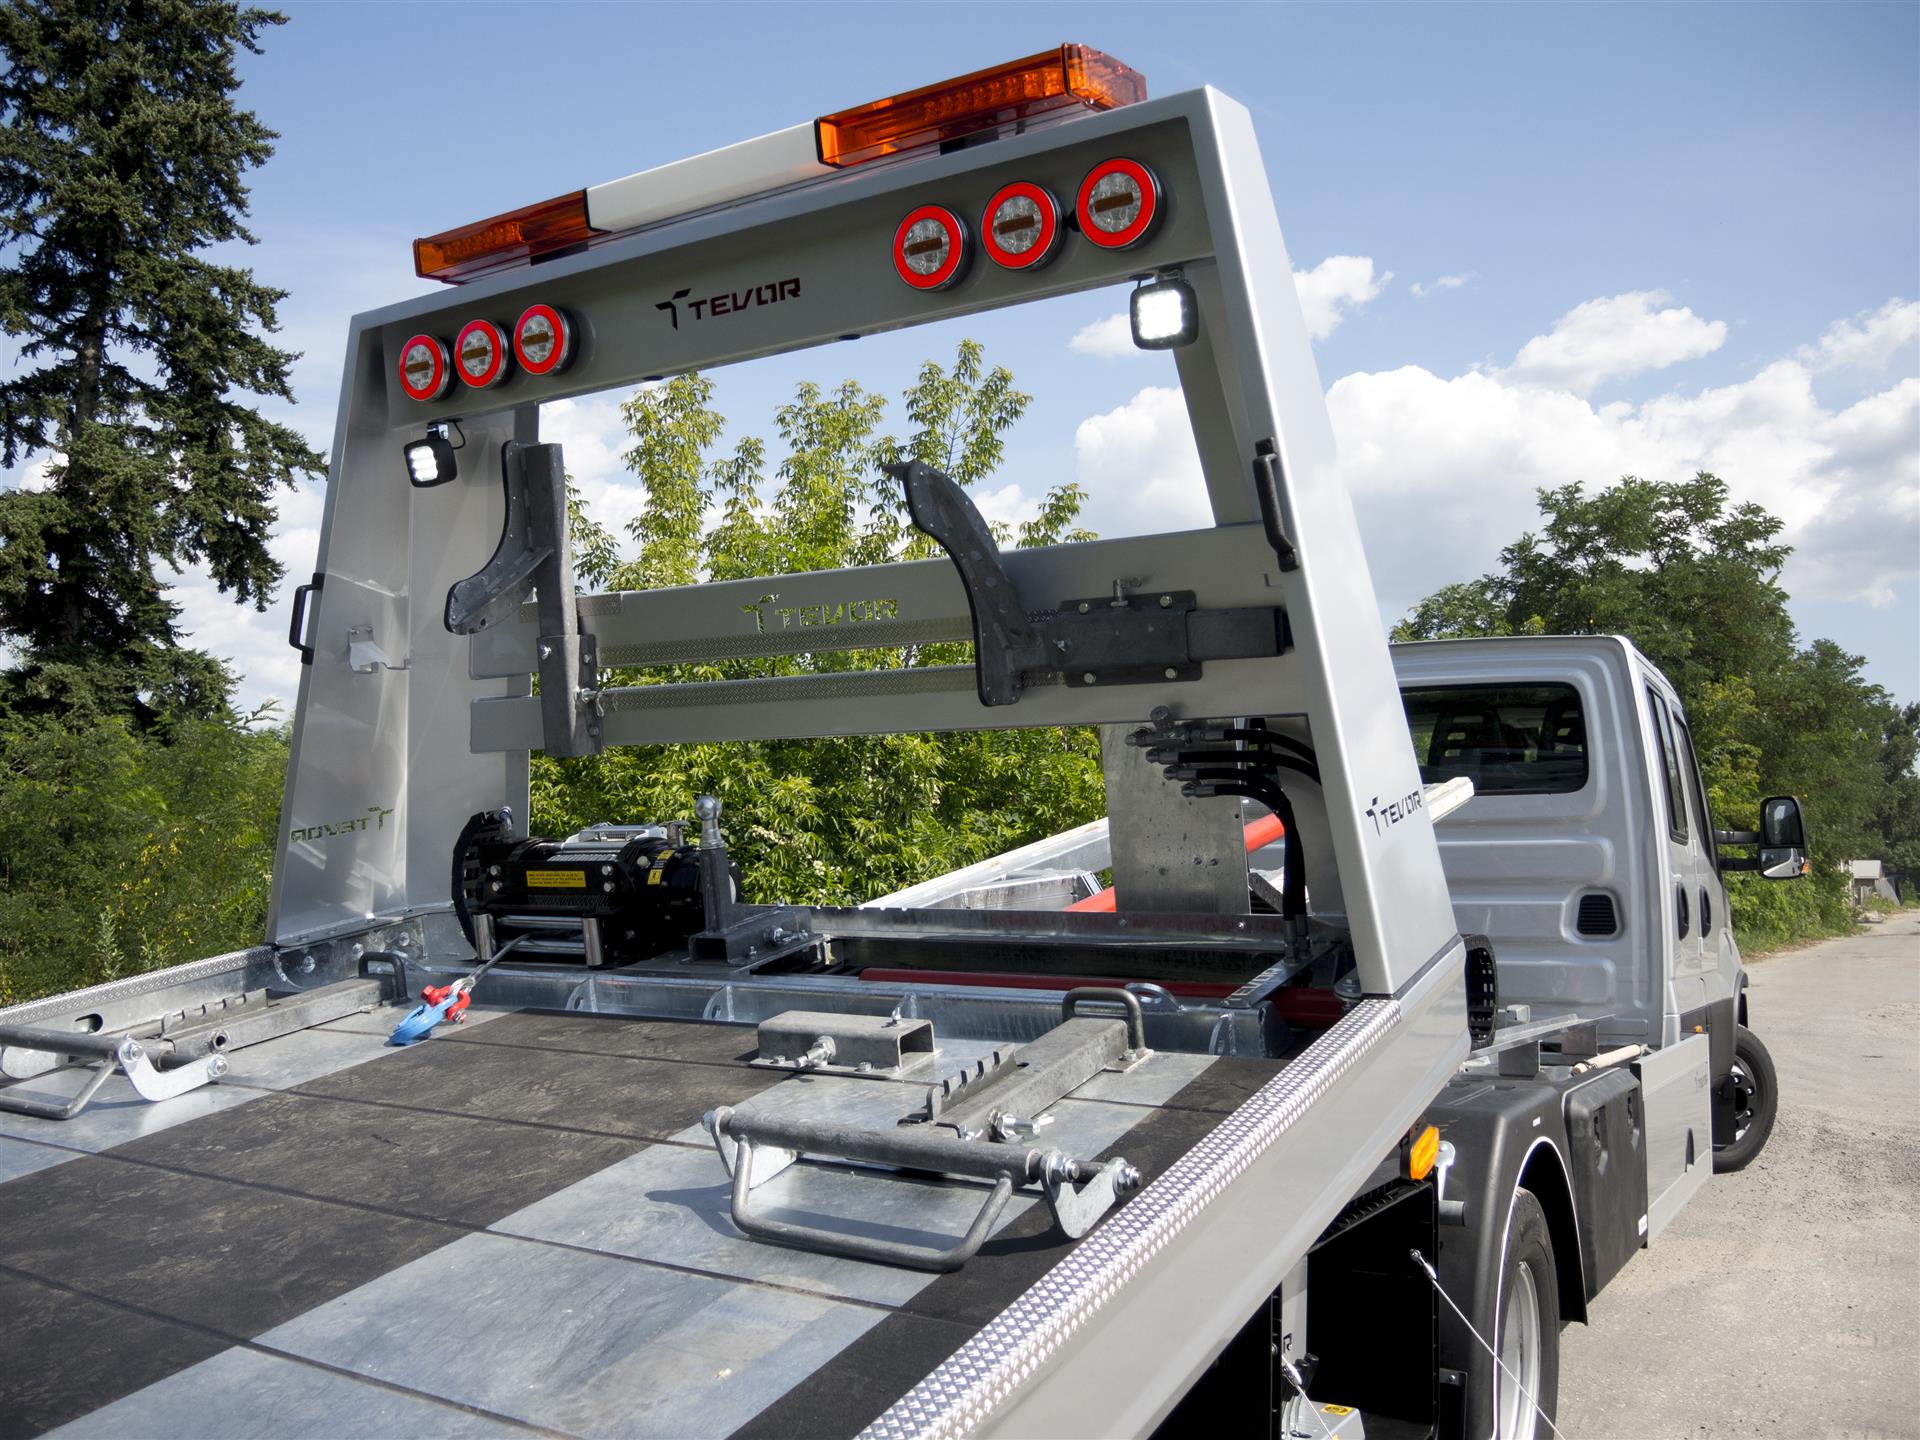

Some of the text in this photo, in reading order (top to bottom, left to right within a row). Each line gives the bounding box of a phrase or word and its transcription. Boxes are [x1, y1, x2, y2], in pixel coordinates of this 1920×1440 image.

[688, 278, 800, 320] TEVOR
[775, 599, 898, 628] TEVOR
[1380, 791, 1422, 828] TEVOR
